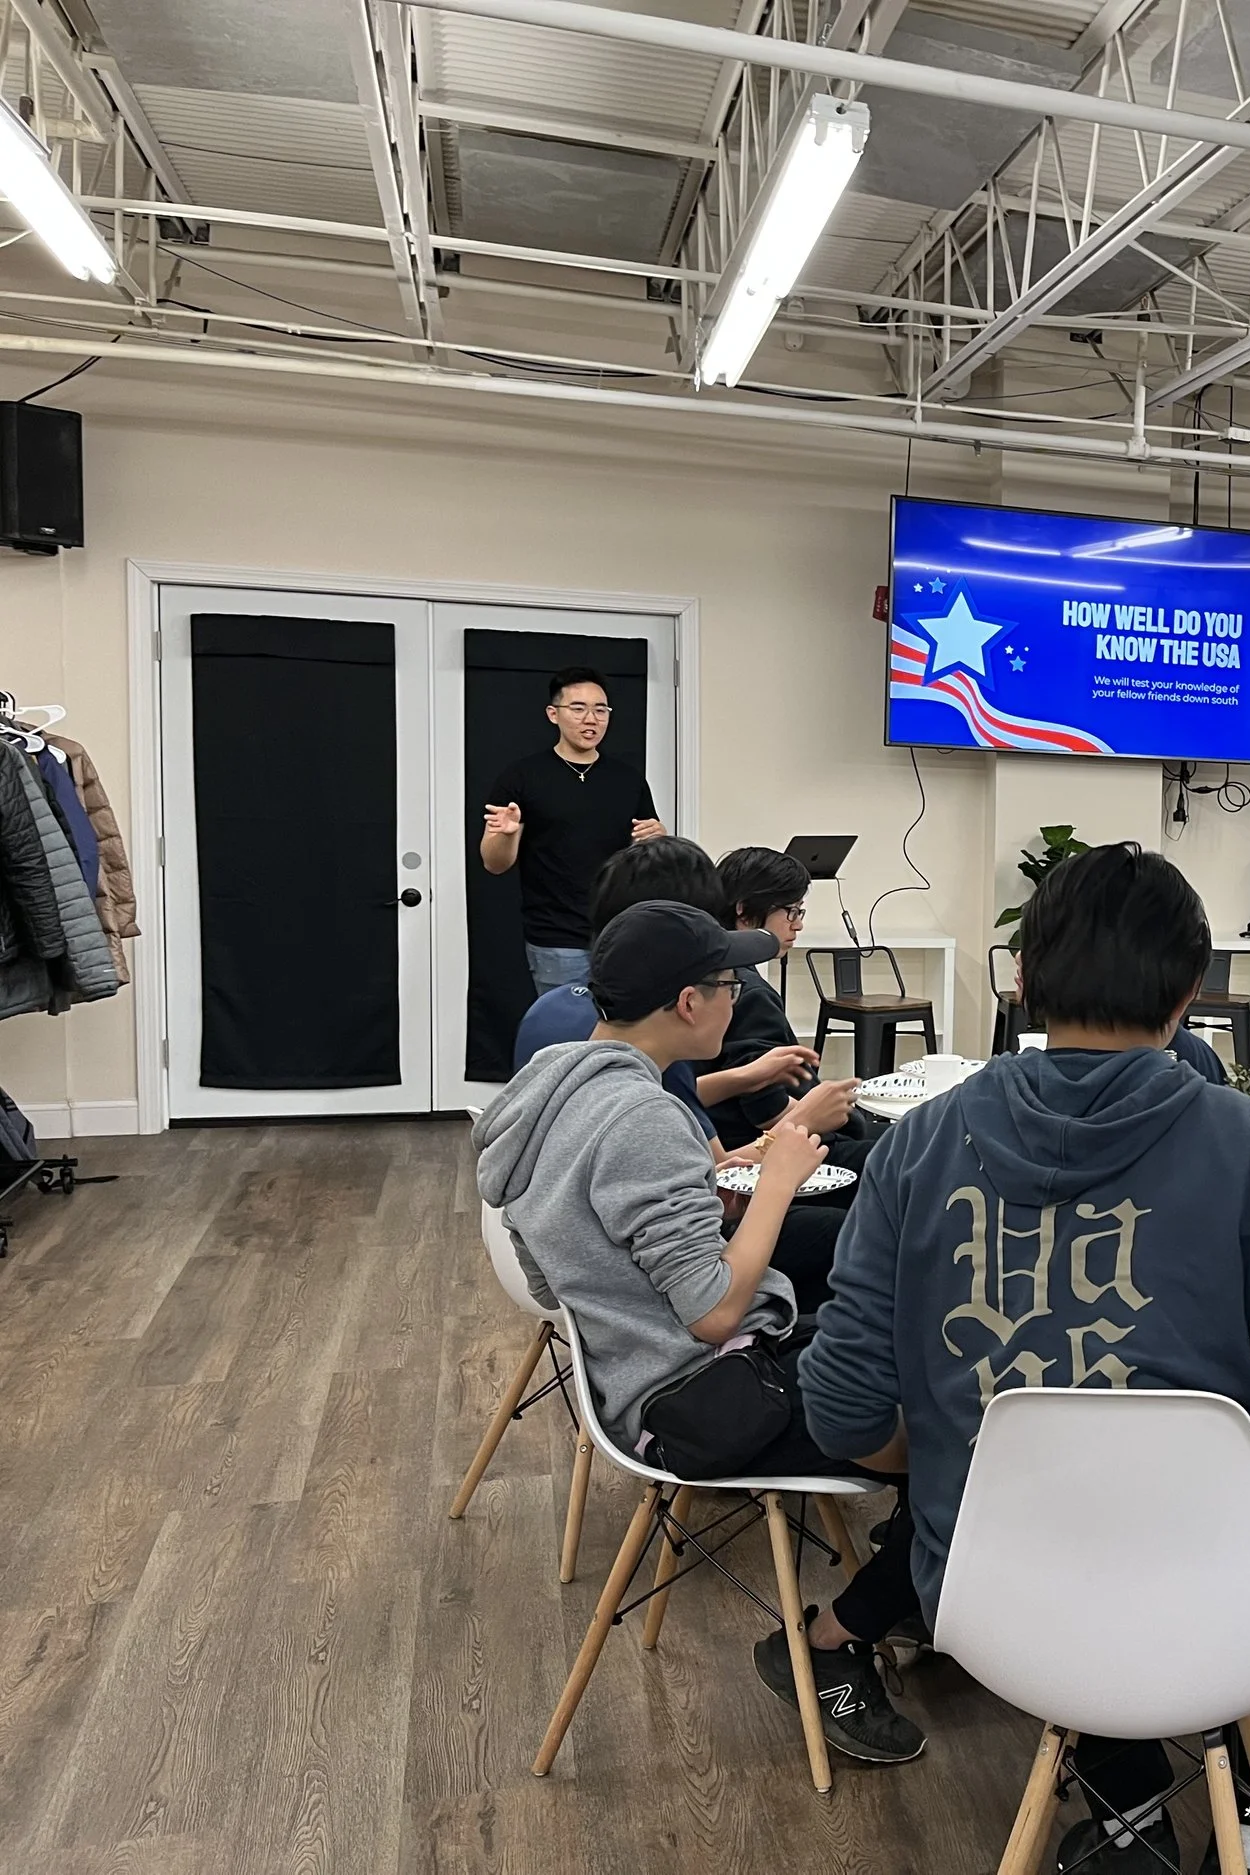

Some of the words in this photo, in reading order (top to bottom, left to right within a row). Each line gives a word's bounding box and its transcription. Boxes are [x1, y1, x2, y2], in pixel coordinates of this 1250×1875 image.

[1062, 600, 1111, 629] HOW
[1114, 604, 1170, 634] WELL
[1173, 609, 1201, 636] DO
[1204, 611, 1243, 639] YOU
[1096, 633, 1158, 663] KNOW
[1160, 639, 1199, 666] THE
[1202, 641, 1241, 669] USA
[1092, 689, 1115, 699] your
[1117, 689, 1147, 700] fellow
[1148, 691, 1181, 702] friends
[1182, 693, 1210, 704] down
[1211, 695, 1239, 706] south
[1094, 675, 1111, 685] We
[1112, 677, 1129, 687] will
[1131, 678, 1150, 688] test
[1151, 681, 1173, 690] your
[1175, 681, 1228, 695] knowledge
[1229, 684, 1240, 694] of
